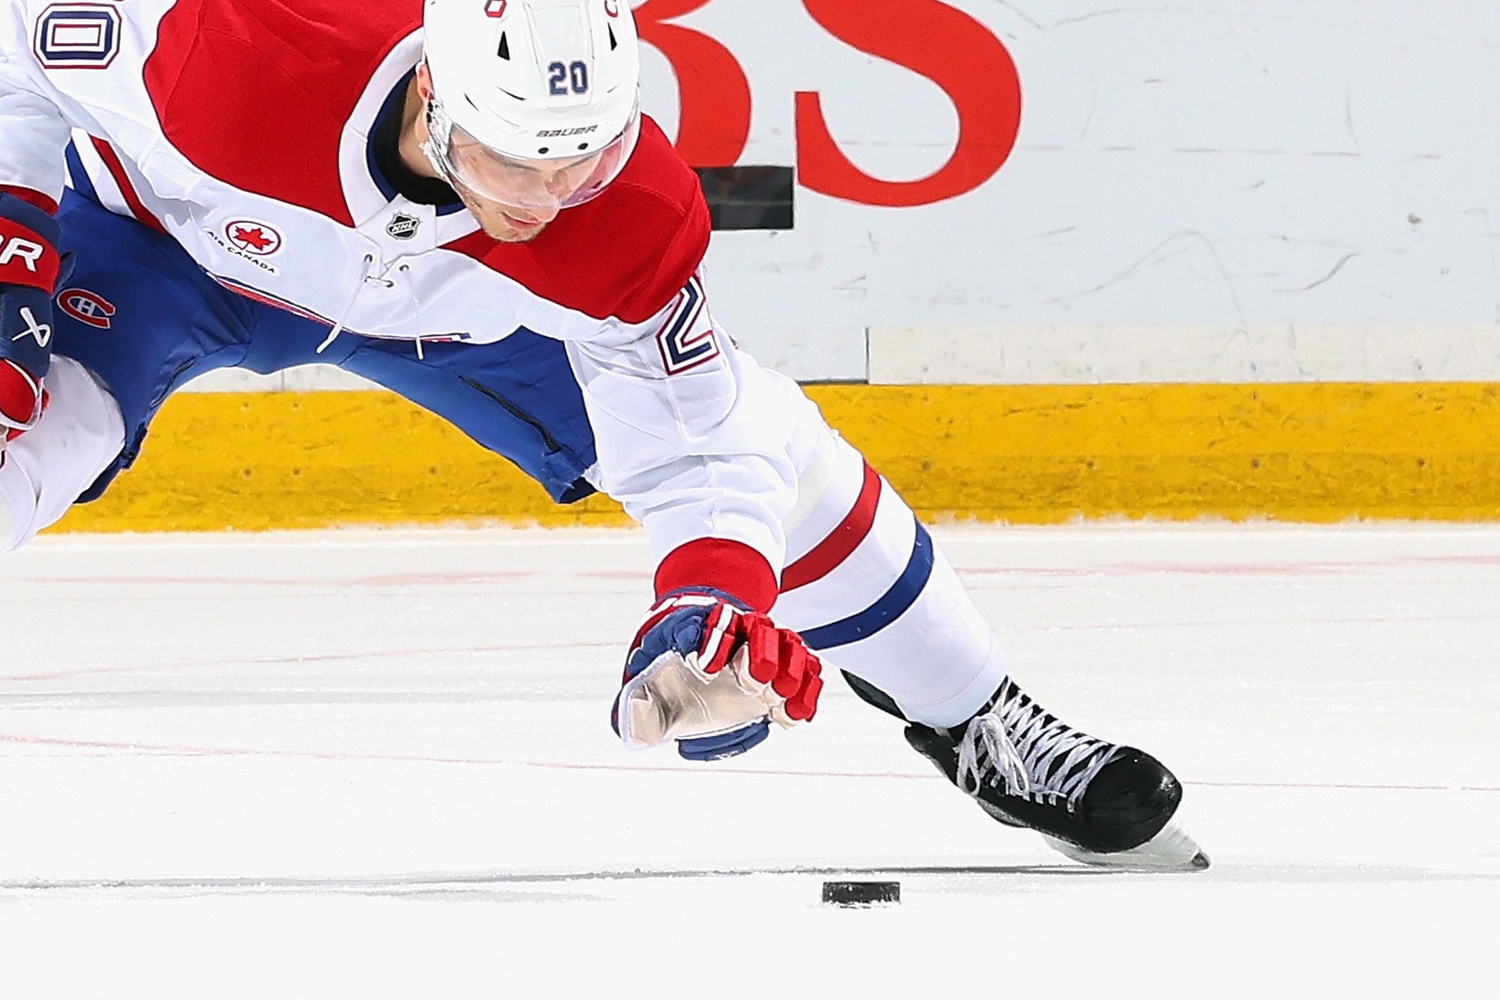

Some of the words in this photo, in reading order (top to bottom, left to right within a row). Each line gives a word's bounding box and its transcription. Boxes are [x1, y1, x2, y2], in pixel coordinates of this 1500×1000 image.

[547, 60, 588, 96] 20
[535, 124, 598, 138] BAUER
[206, 230, 225, 248] AIR
[226, 246, 276, 274] CANADA
